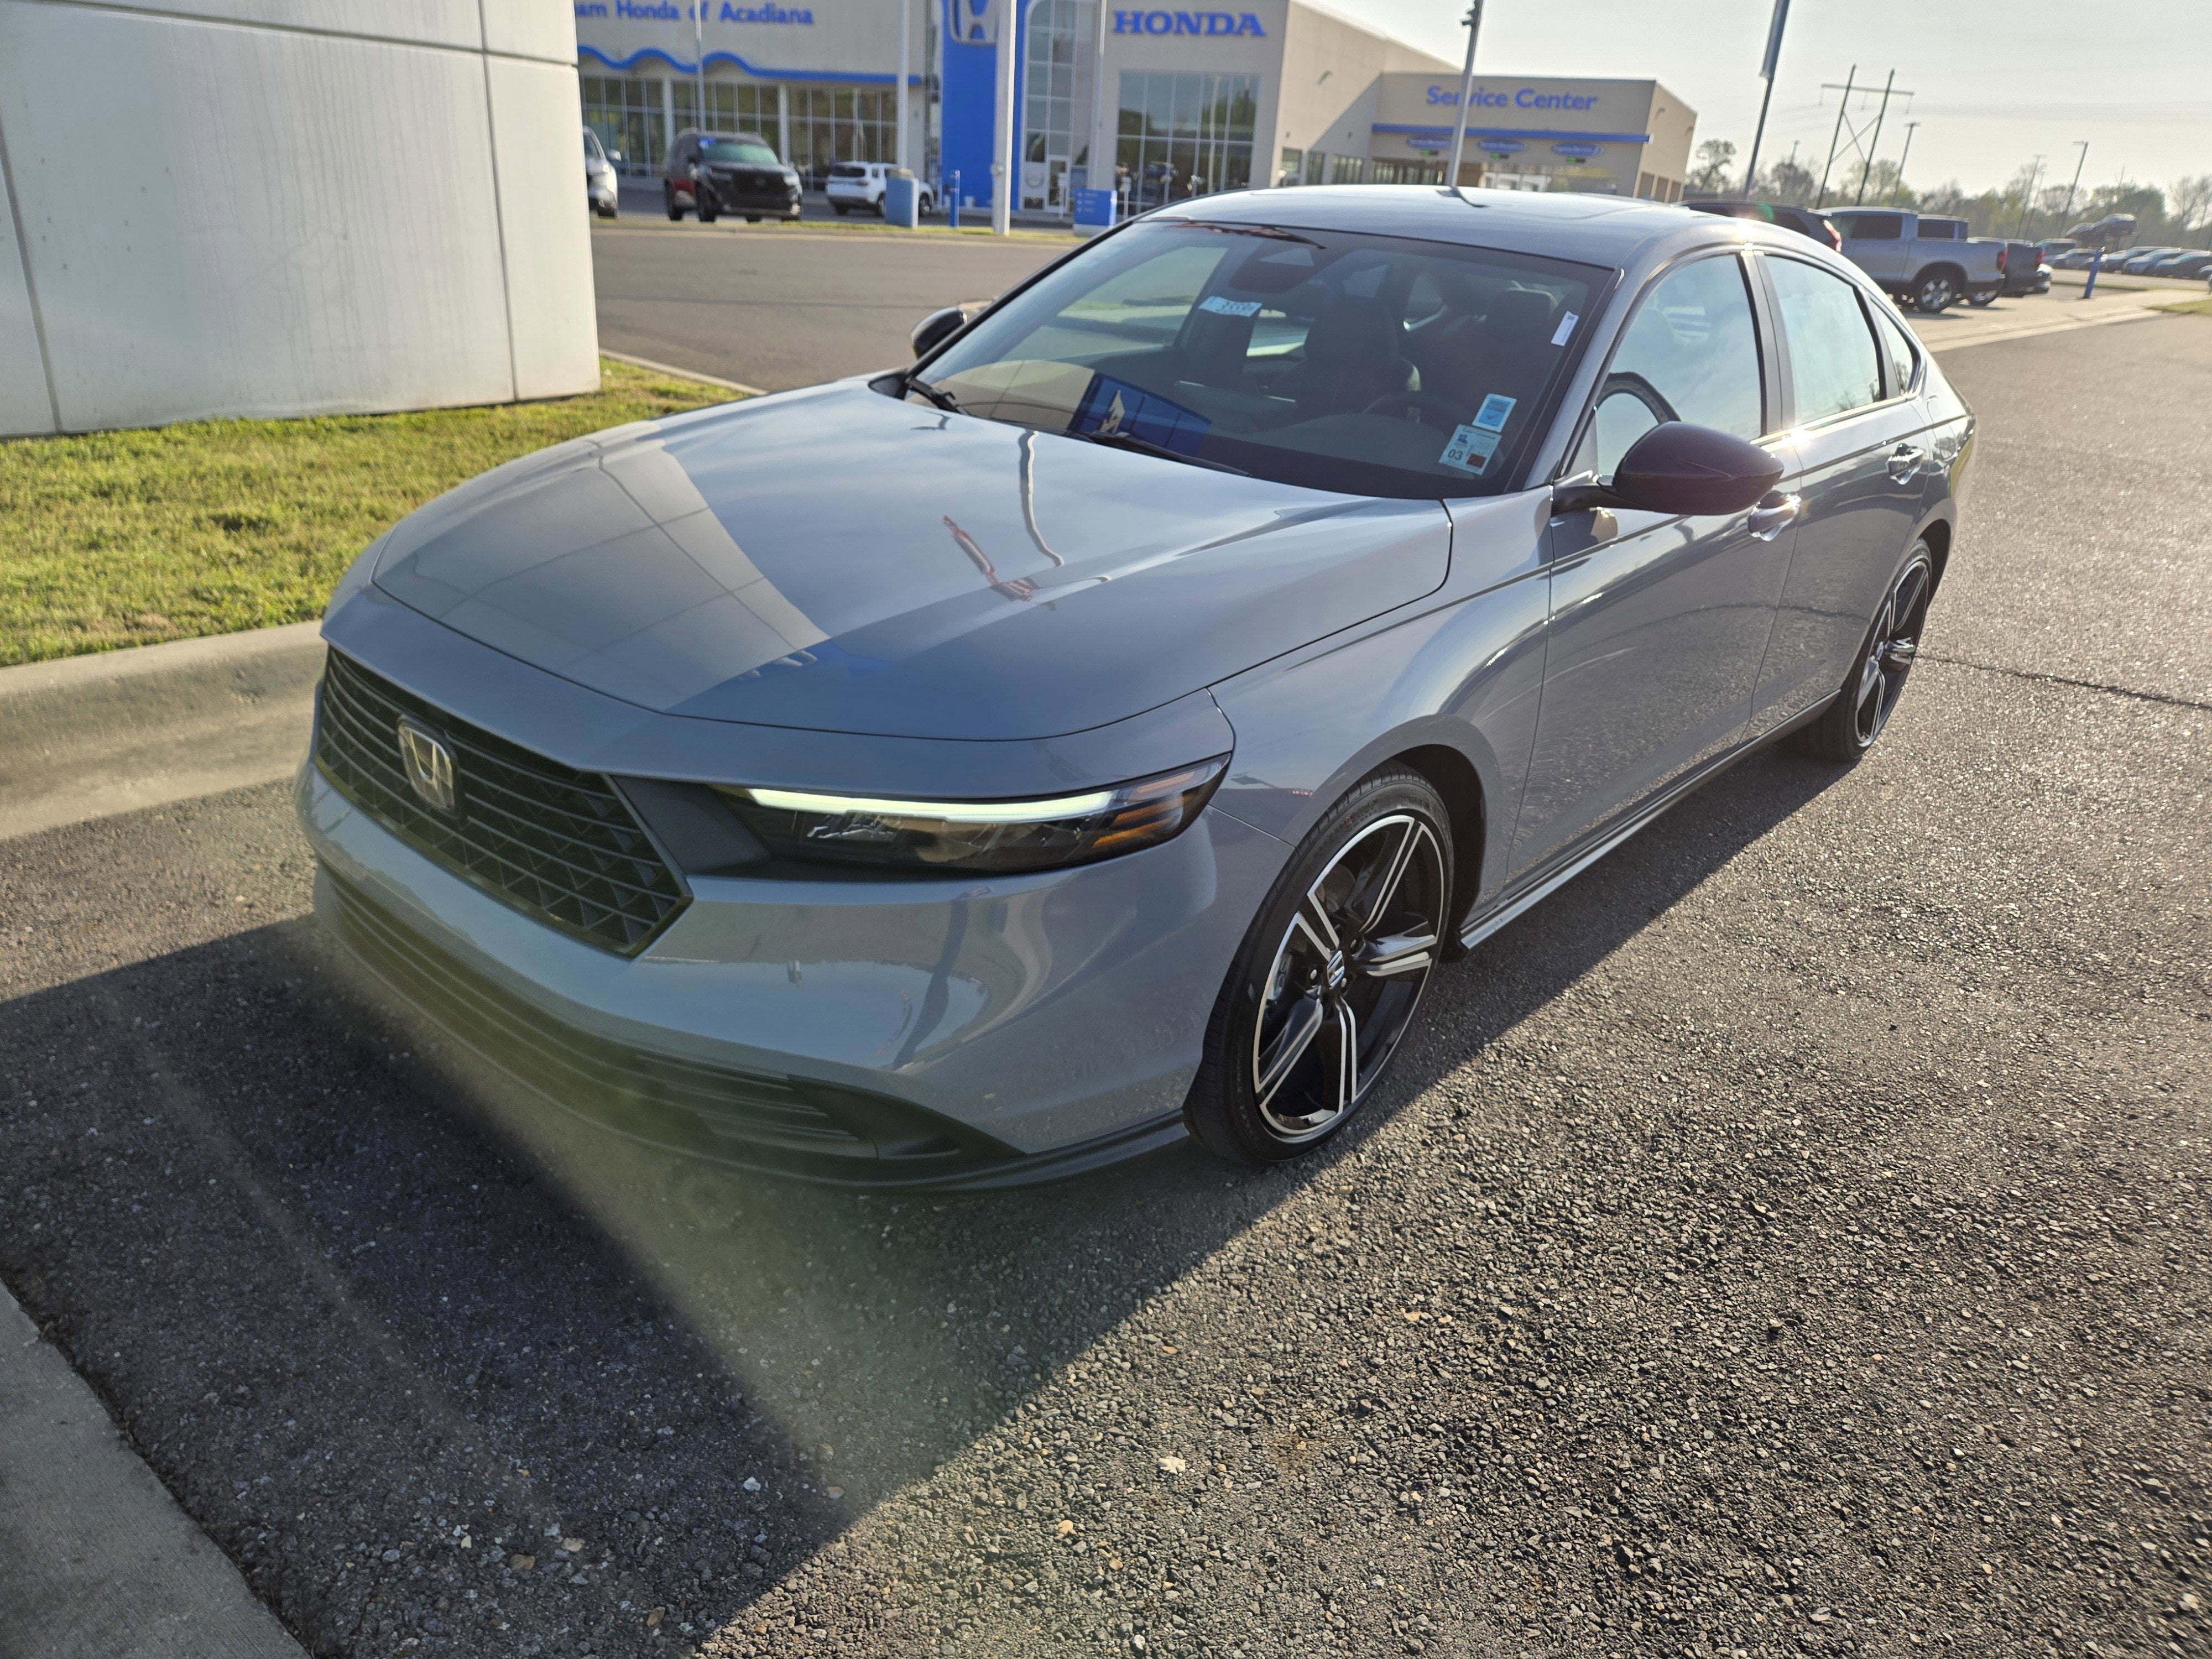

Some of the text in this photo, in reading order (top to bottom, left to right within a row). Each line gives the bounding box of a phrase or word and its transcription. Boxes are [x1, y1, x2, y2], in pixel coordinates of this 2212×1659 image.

[616, 0, 680, 20] Honda
[720, 1, 813, 24] Acadiana
[1113, 10, 1266, 36] HONDA
[1426, 85, 1598, 109] Service Center
[1447, 448, 1463, 461] 03
